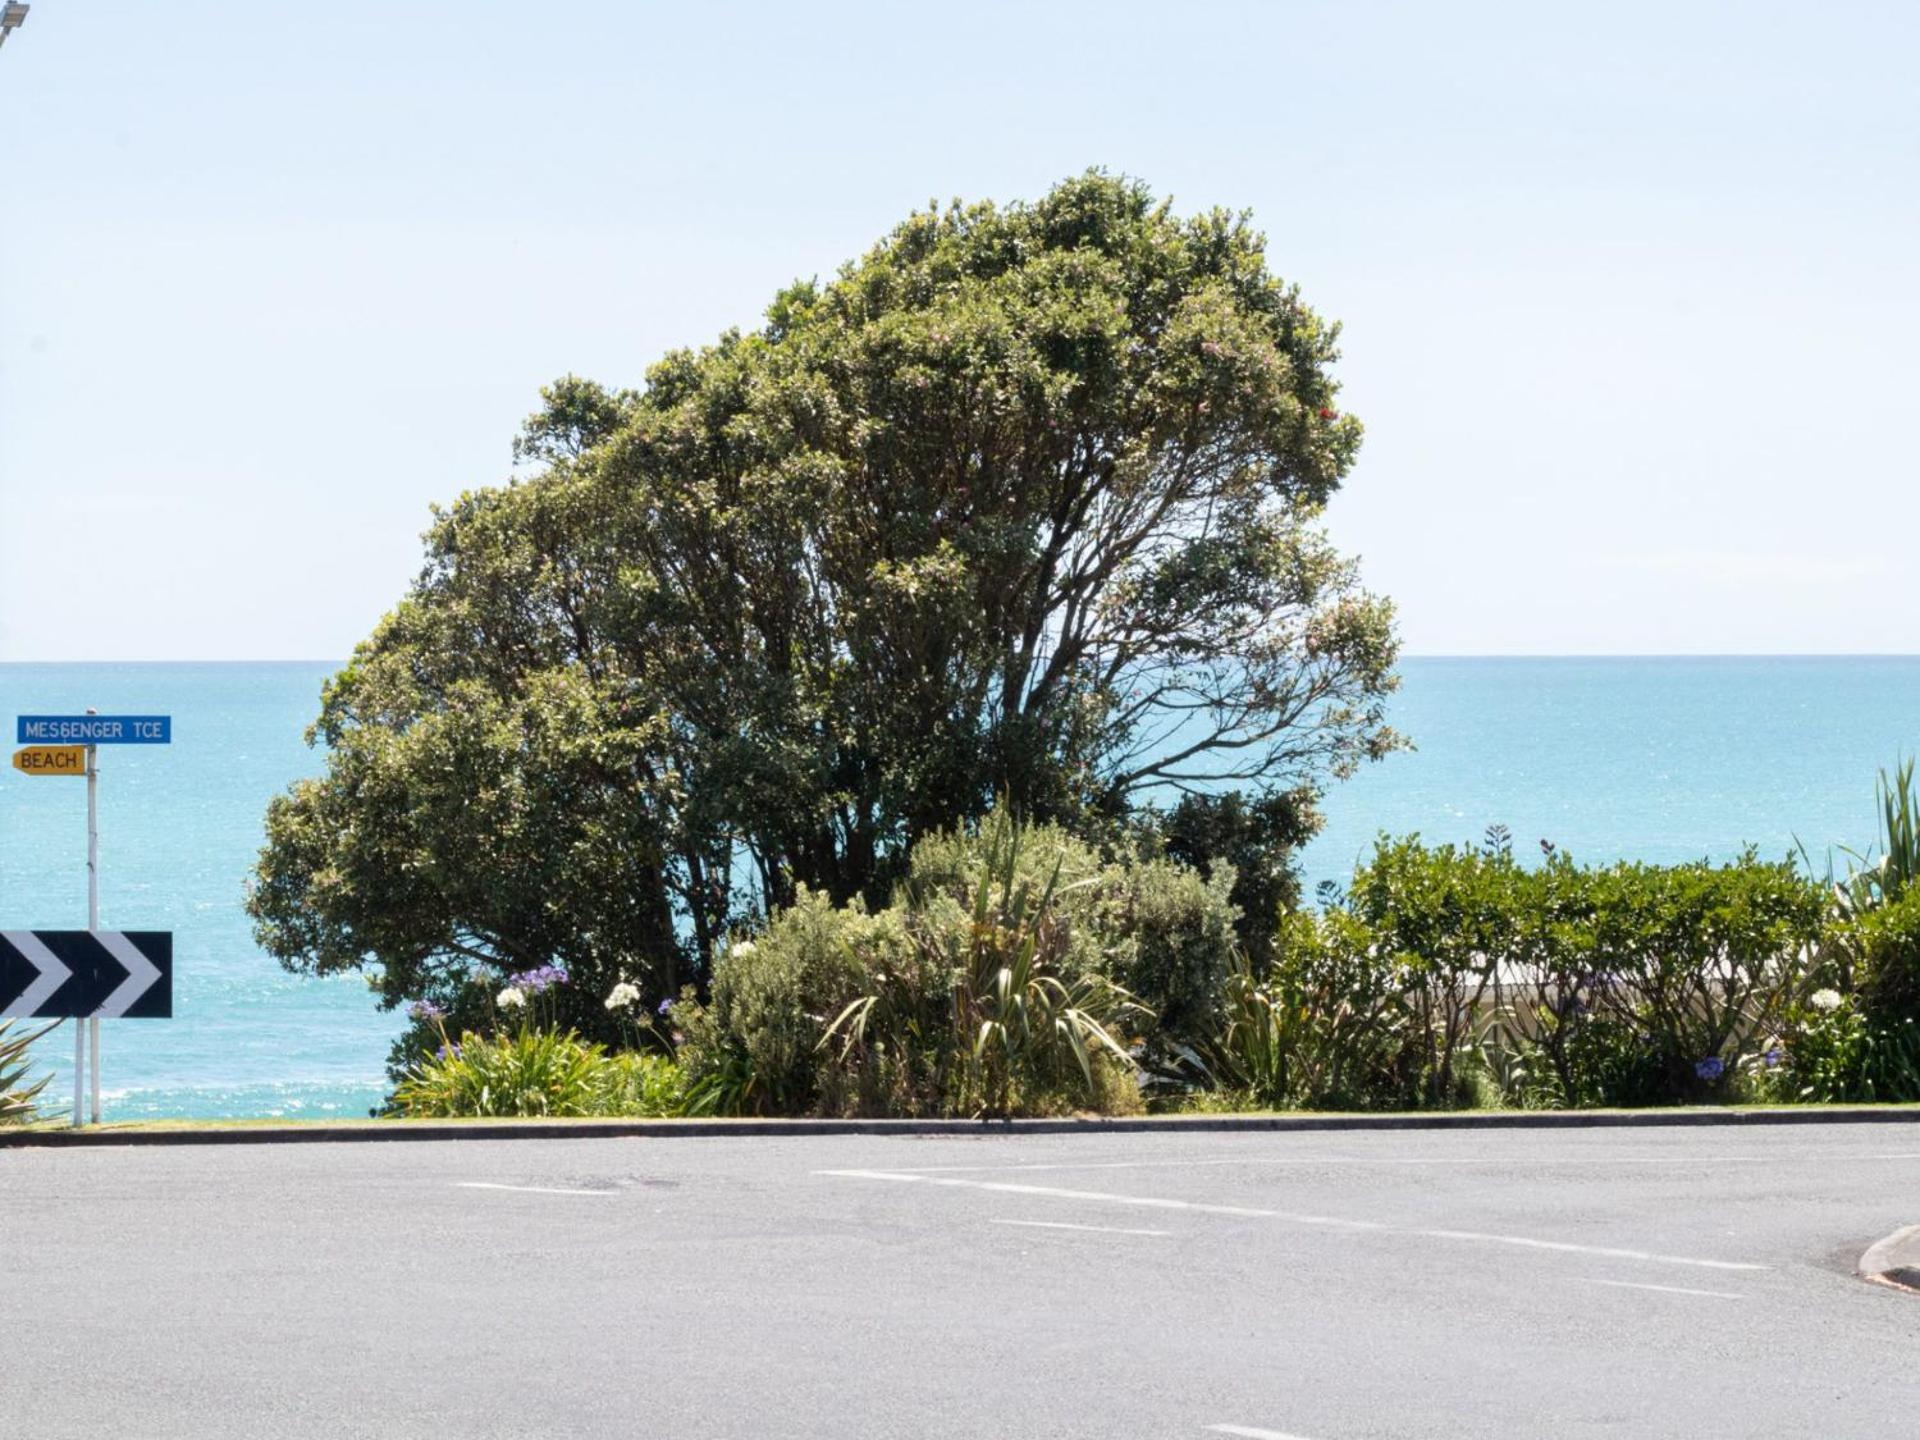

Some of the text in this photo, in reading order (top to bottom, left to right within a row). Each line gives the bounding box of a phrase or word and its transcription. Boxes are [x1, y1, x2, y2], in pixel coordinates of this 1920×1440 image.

[25, 721, 163, 739] MESSENGER TCE
[21, 752, 77, 769] BEACH
